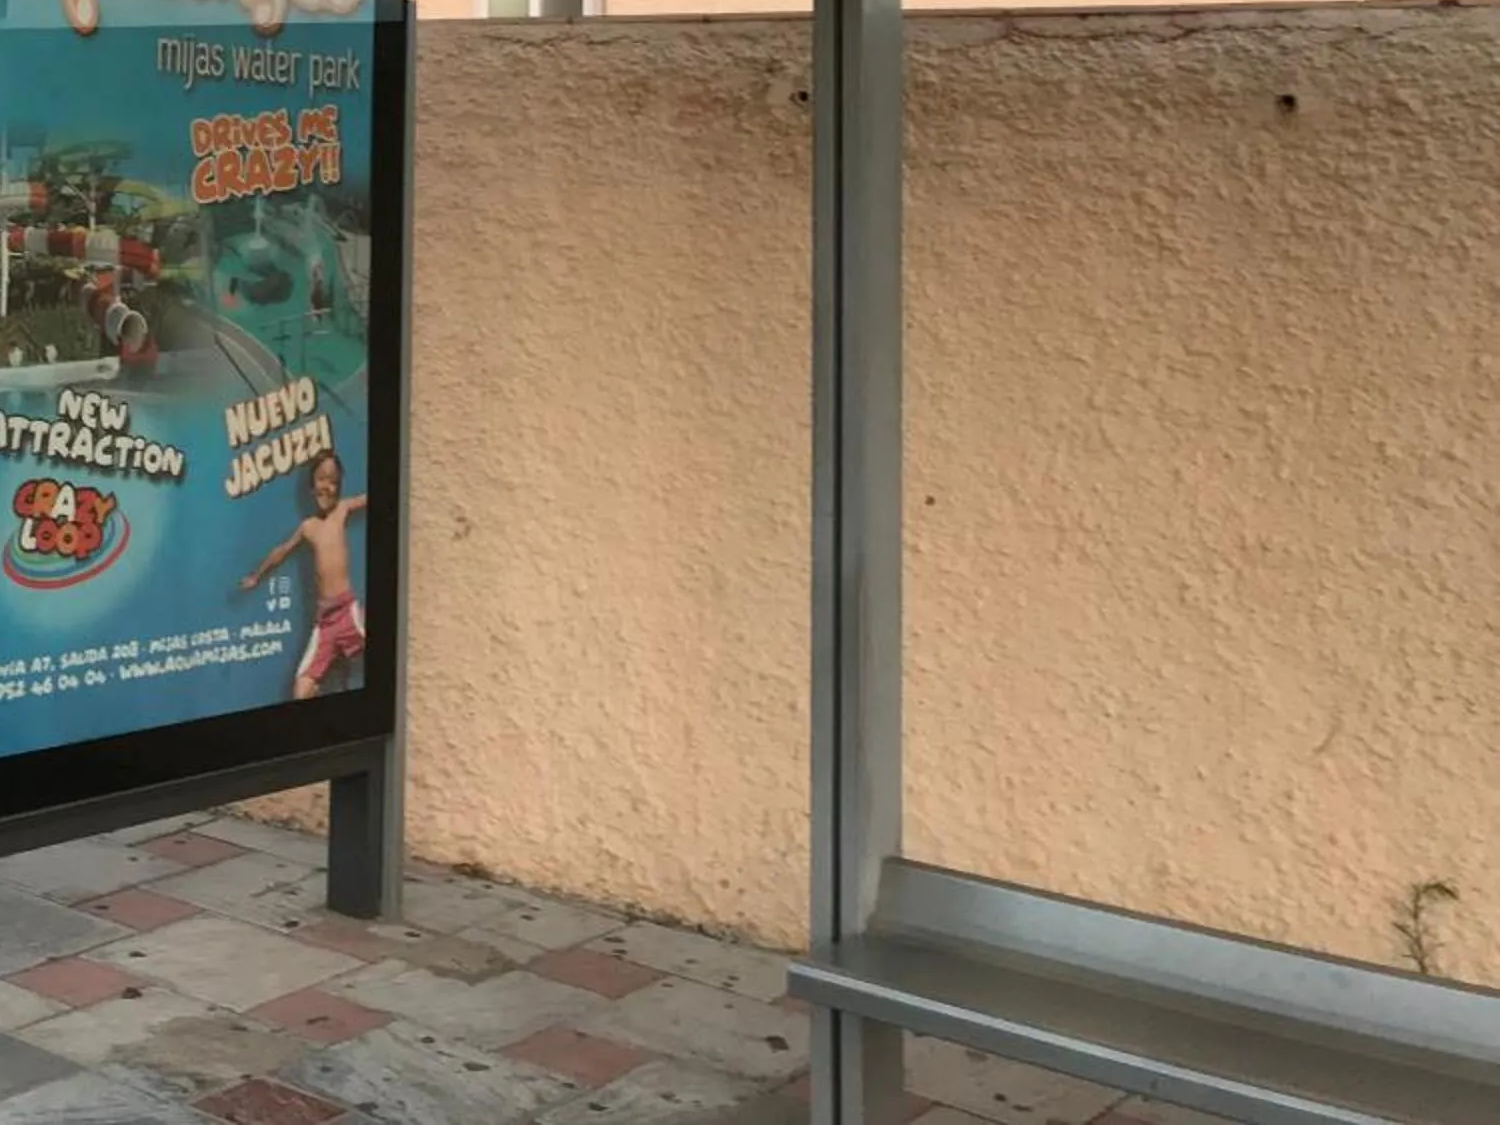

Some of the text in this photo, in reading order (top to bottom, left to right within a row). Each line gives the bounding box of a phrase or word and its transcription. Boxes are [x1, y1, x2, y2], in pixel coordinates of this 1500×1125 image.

[156, 33, 361, 98] mijas water park
[297, 104, 339, 143] ME
[191, 141, 341, 204] CRAZY!!
[57, 388, 129, 430] NEW
[225, 376, 317, 448] NUEVO
[225, 414, 333, 497] JACUZZI
[13, 478, 117, 525] CRAZY
[19, 517, 104, 561] LOOP
